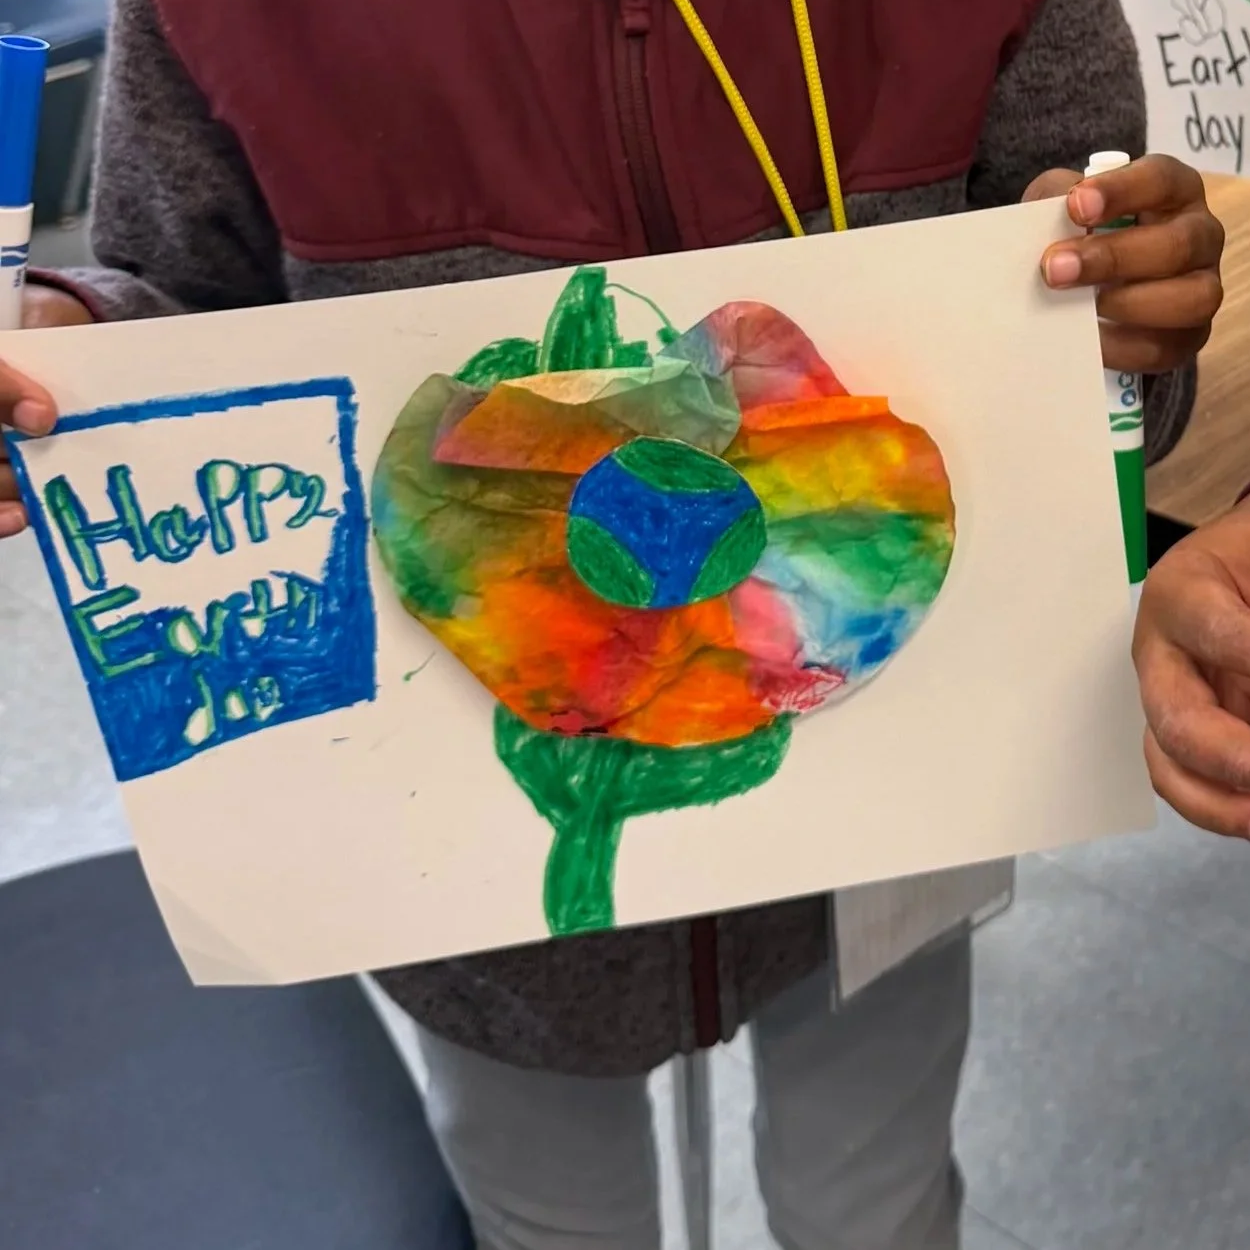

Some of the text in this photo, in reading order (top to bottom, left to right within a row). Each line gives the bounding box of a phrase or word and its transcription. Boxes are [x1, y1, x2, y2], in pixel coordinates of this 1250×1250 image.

[1184, 90, 1245, 175] day
[43, 458, 341, 591] Happy
[72, 576, 322, 680] Earth
